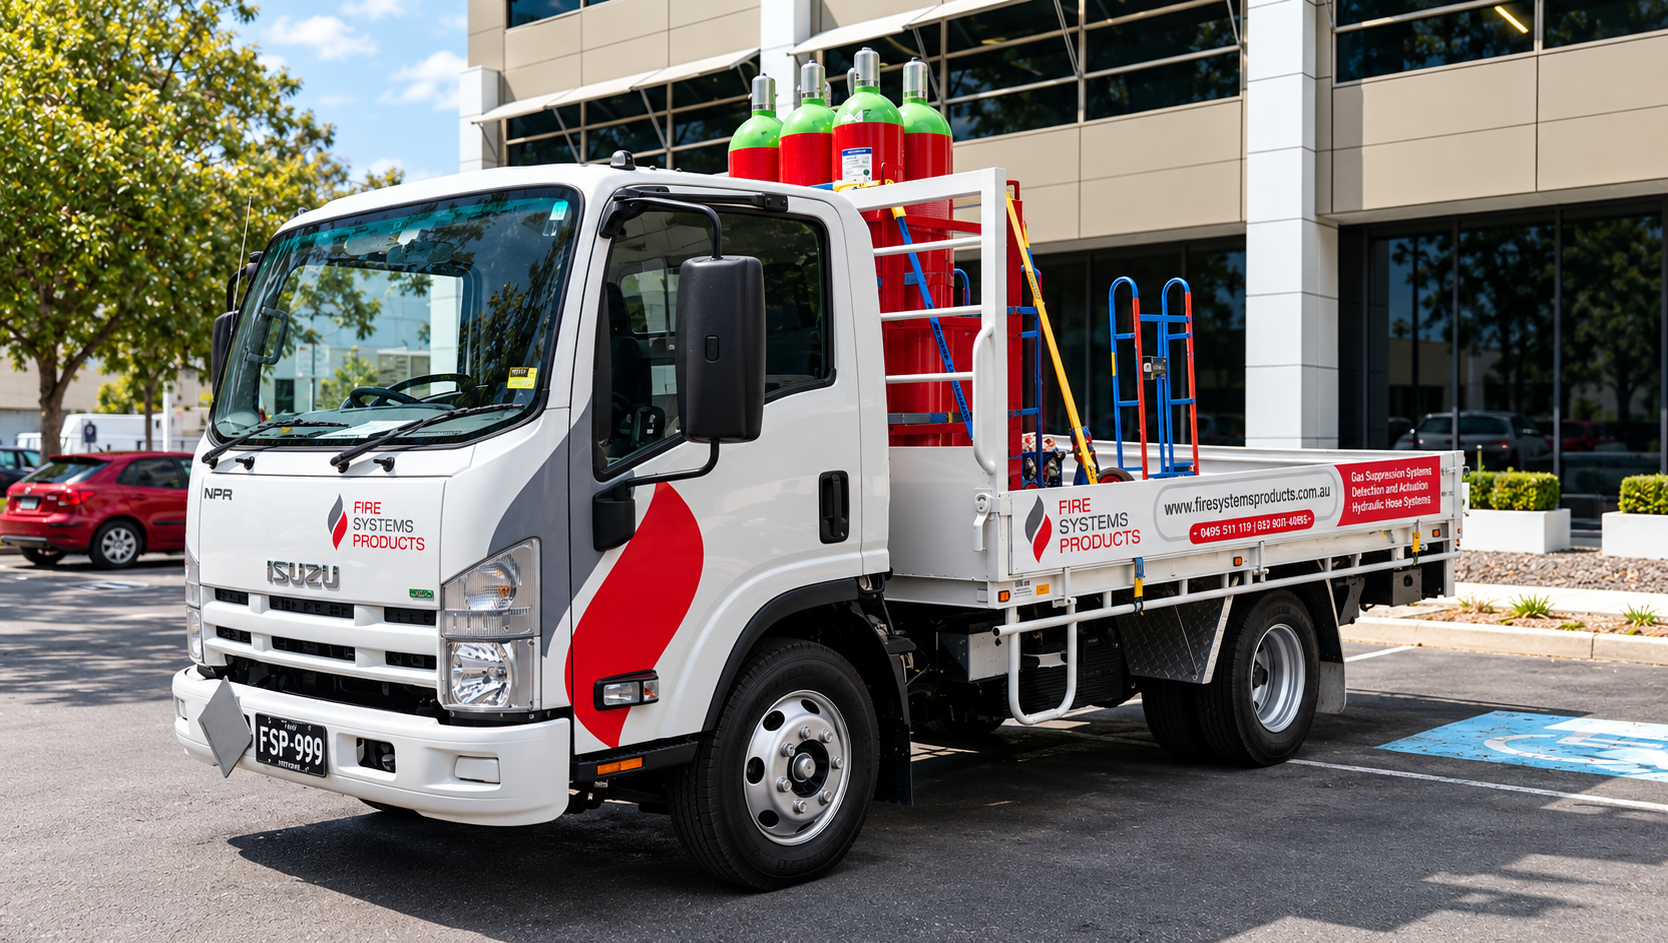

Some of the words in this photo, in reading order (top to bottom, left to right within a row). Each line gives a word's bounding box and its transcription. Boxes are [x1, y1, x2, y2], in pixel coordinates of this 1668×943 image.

[1351, 471, 1364, 482] Gas
[1365, 468, 1405, 482] Suppression
[1406, 467, 1432, 479] Systems
[204, 487, 233, 501] NPR
[1351, 484, 1385, 497] Detection
[1385, 483, 1398, 494] and
[1399, 480, 1429, 492] Actuation
[353, 501, 382, 515] FIRE
[1059, 497, 1091, 515] FIRE
[1164, 486, 1331, 516] www.firesystemsproducts.com.au
[1352, 499, 1384, 515] Hydraulic
[1385, 498, 1402, 508] Hose
[1403, 496, 1431, 509] Systems
[353, 517, 414, 533] SYSTEMS
[1059, 512, 1129, 535] SYSTEMS
[1222, 524, 1236, 535] 511
[1238, 522, 1252, 533] 119
[353, 534, 425, 551] PRODUCTS
[1060, 529, 1141, 554] PRODUCTS
[266, 560, 340, 589] ISUZU
